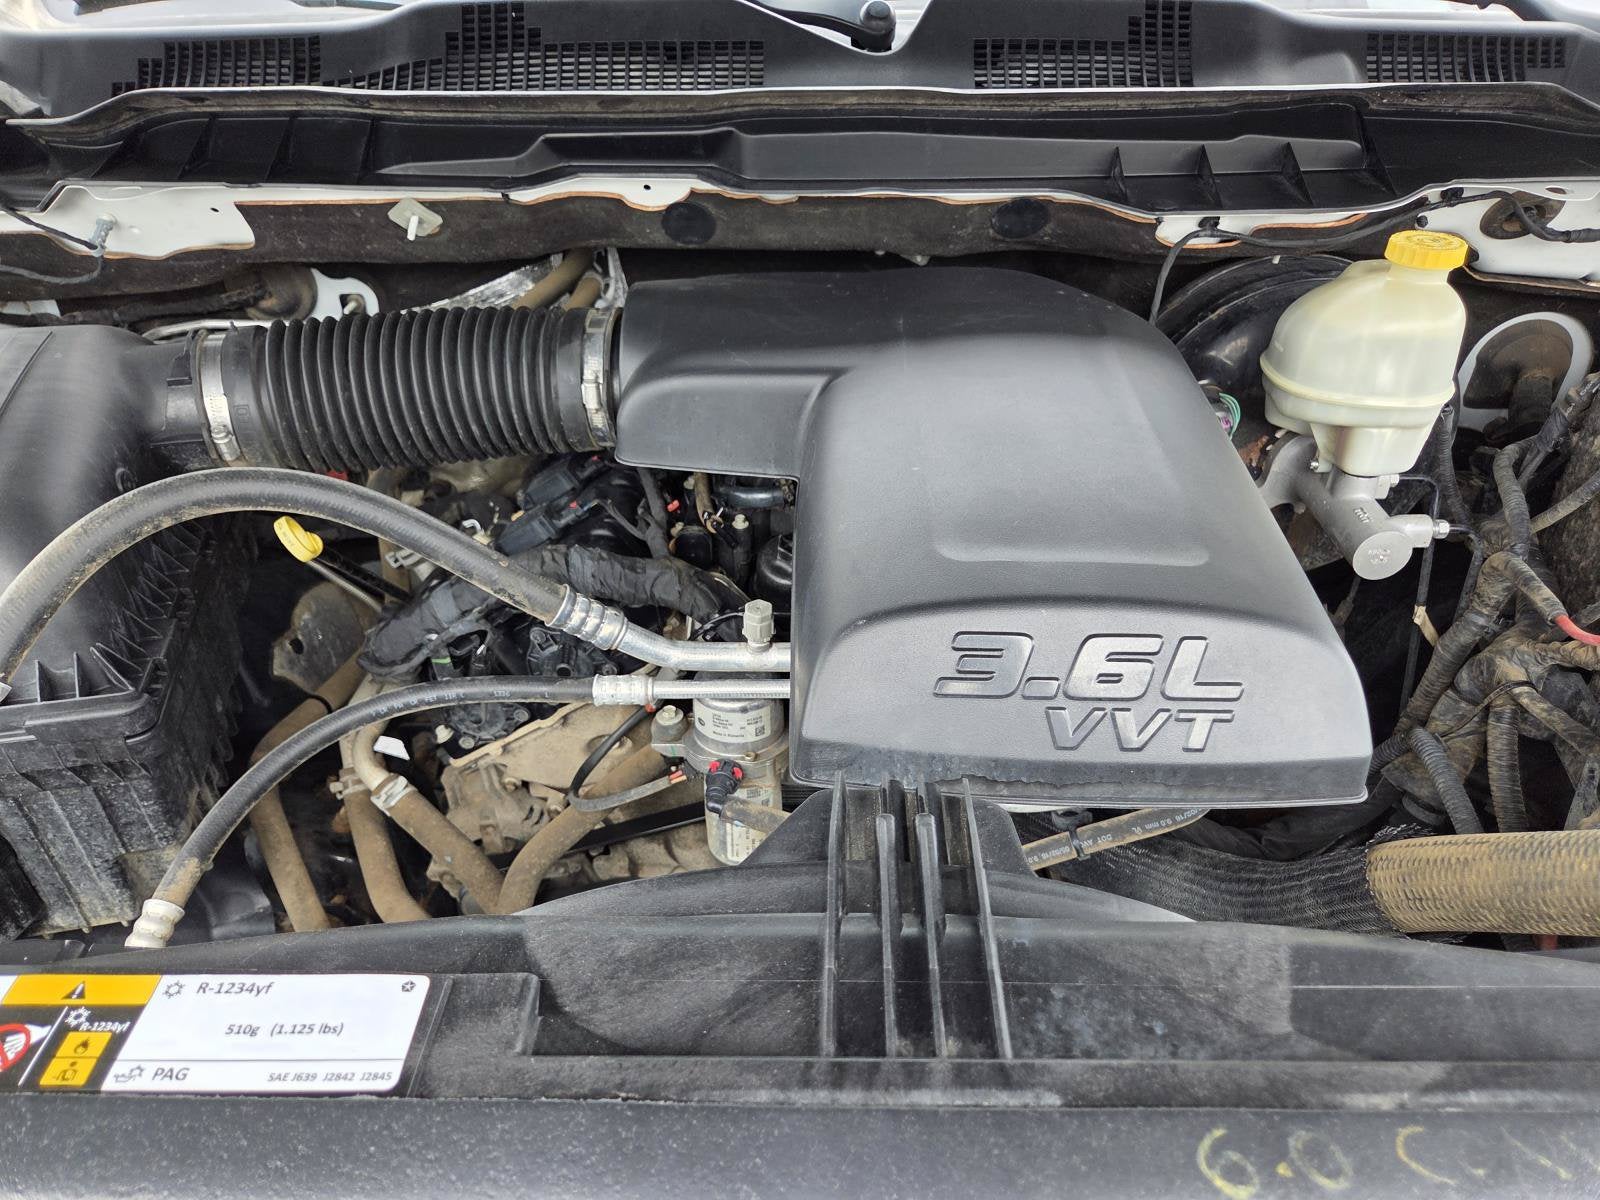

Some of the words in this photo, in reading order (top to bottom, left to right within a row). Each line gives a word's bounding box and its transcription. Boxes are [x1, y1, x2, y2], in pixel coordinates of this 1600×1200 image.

[933, 631, 1244, 701] 3.6L
[1045, 706, 1234, 752] VVT
[196, 981, 275, 997] R-1234yf
[224, 1023, 260, 1037] 510g
[270, 1023, 315, 1037] (1.125
[317, 1022, 344, 1037] lbs)
[151, 1067, 190, 1082] PAG
[267, 1072, 289, 1082] SAE
[290, 1072, 317, 1083] J639
[322, 1072, 356, 1082] J2842
[359, 1071, 393, 1081] J2845
